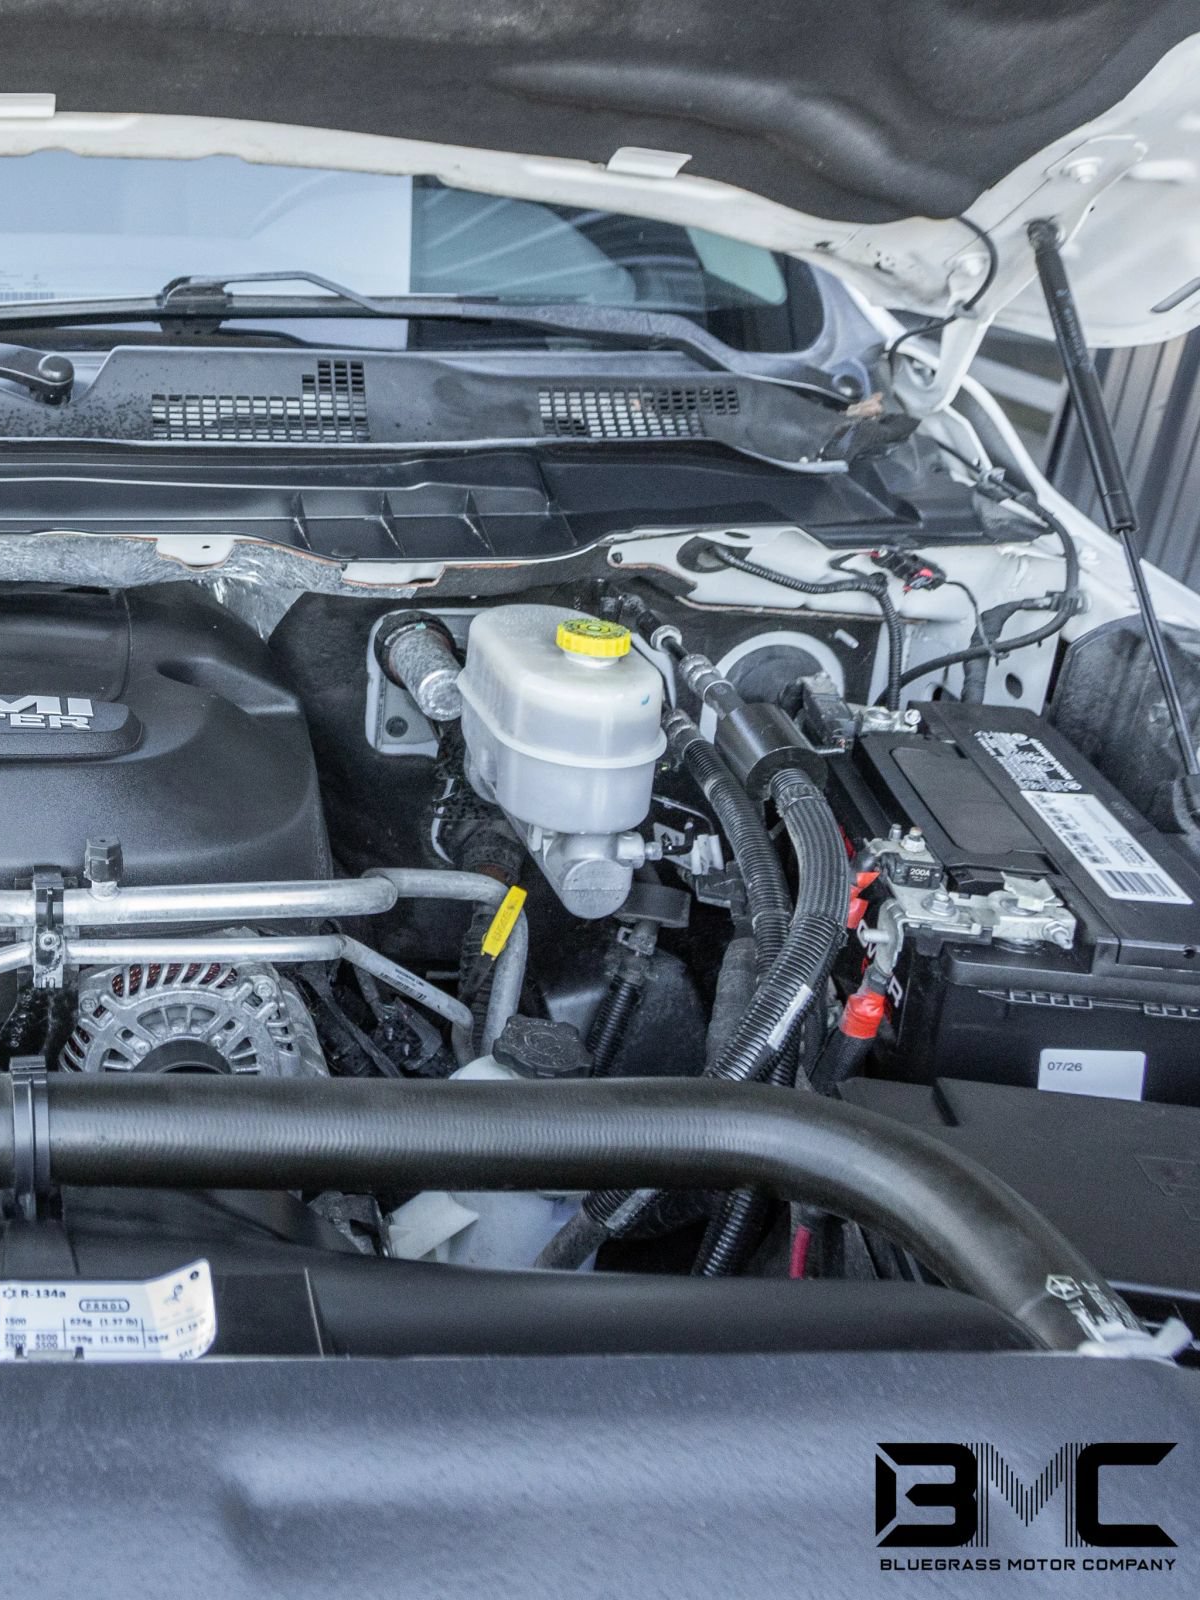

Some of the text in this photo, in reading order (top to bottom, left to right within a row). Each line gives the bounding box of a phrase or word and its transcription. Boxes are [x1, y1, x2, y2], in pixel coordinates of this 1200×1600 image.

[909, 868, 931, 877] 200A
[1047, 1061, 1083, 1073] 07/26
[20, 1289, 67, 1299] R-134a
[4, 1317, 27, 1326] 1500
